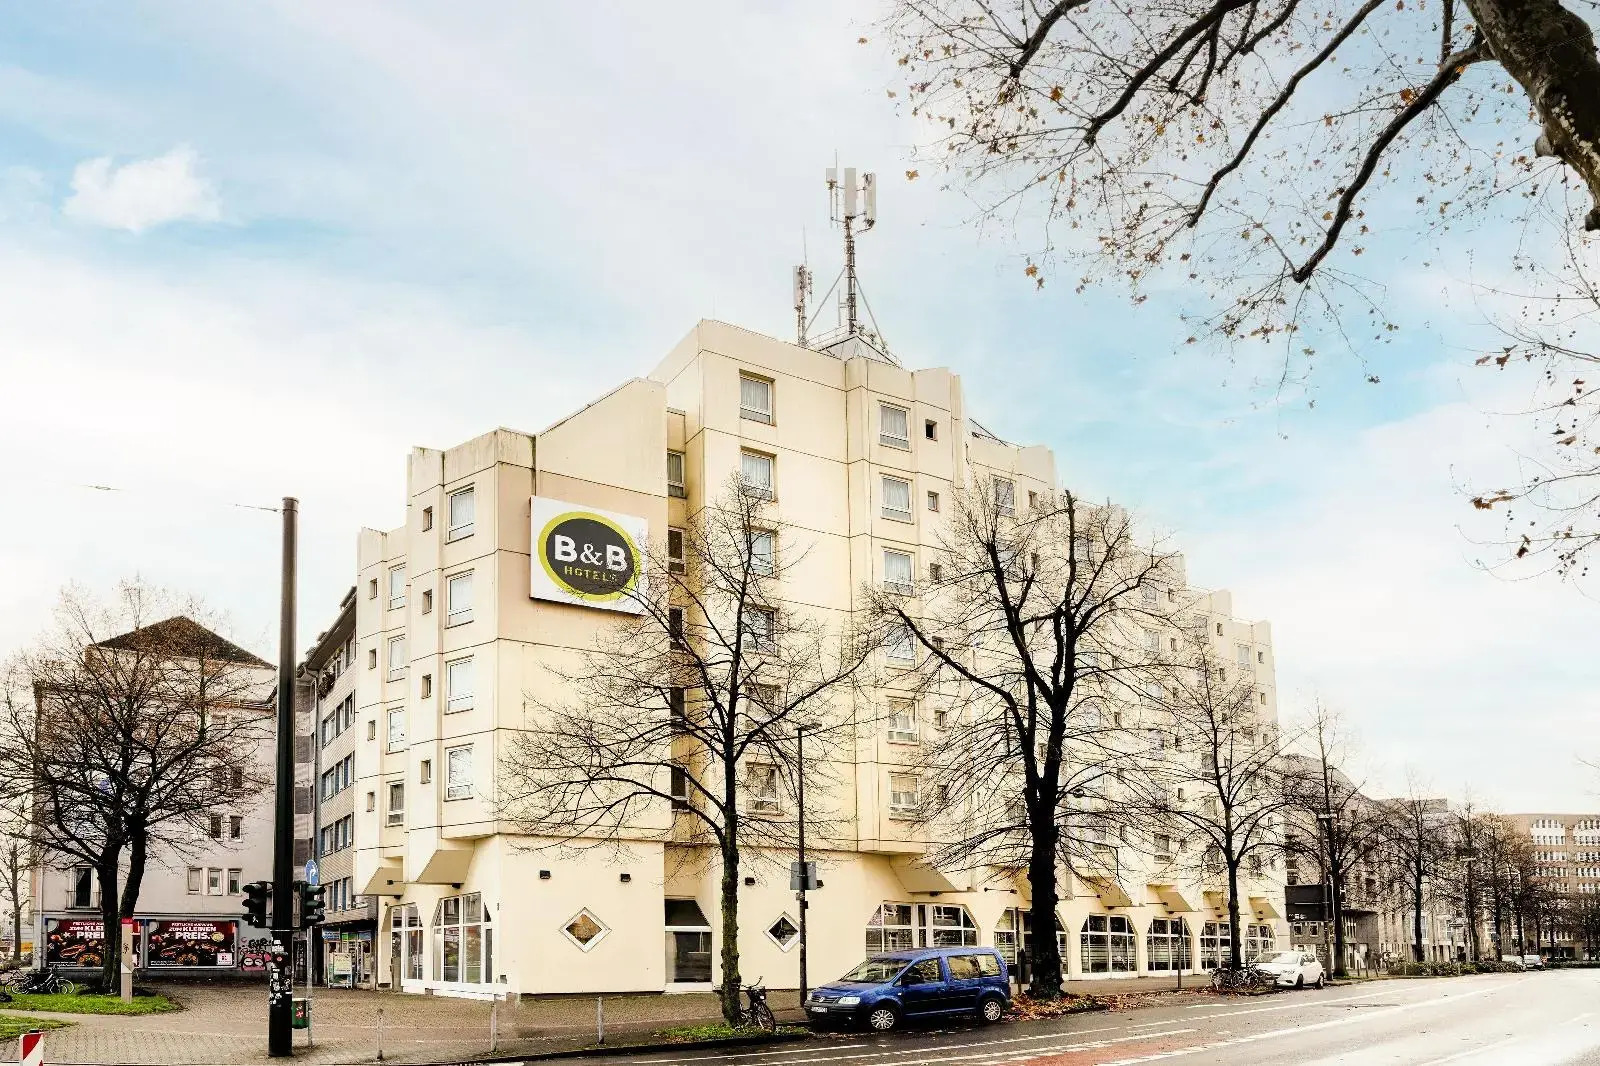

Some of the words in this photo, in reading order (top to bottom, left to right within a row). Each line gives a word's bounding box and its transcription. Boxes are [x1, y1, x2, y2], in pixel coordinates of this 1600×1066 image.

[554, 534, 628, 572] B&B
[564, 565, 617, 583] HOTELS
[76, 931, 104, 939] PREI
[175, 931, 211, 940] PREIS.
